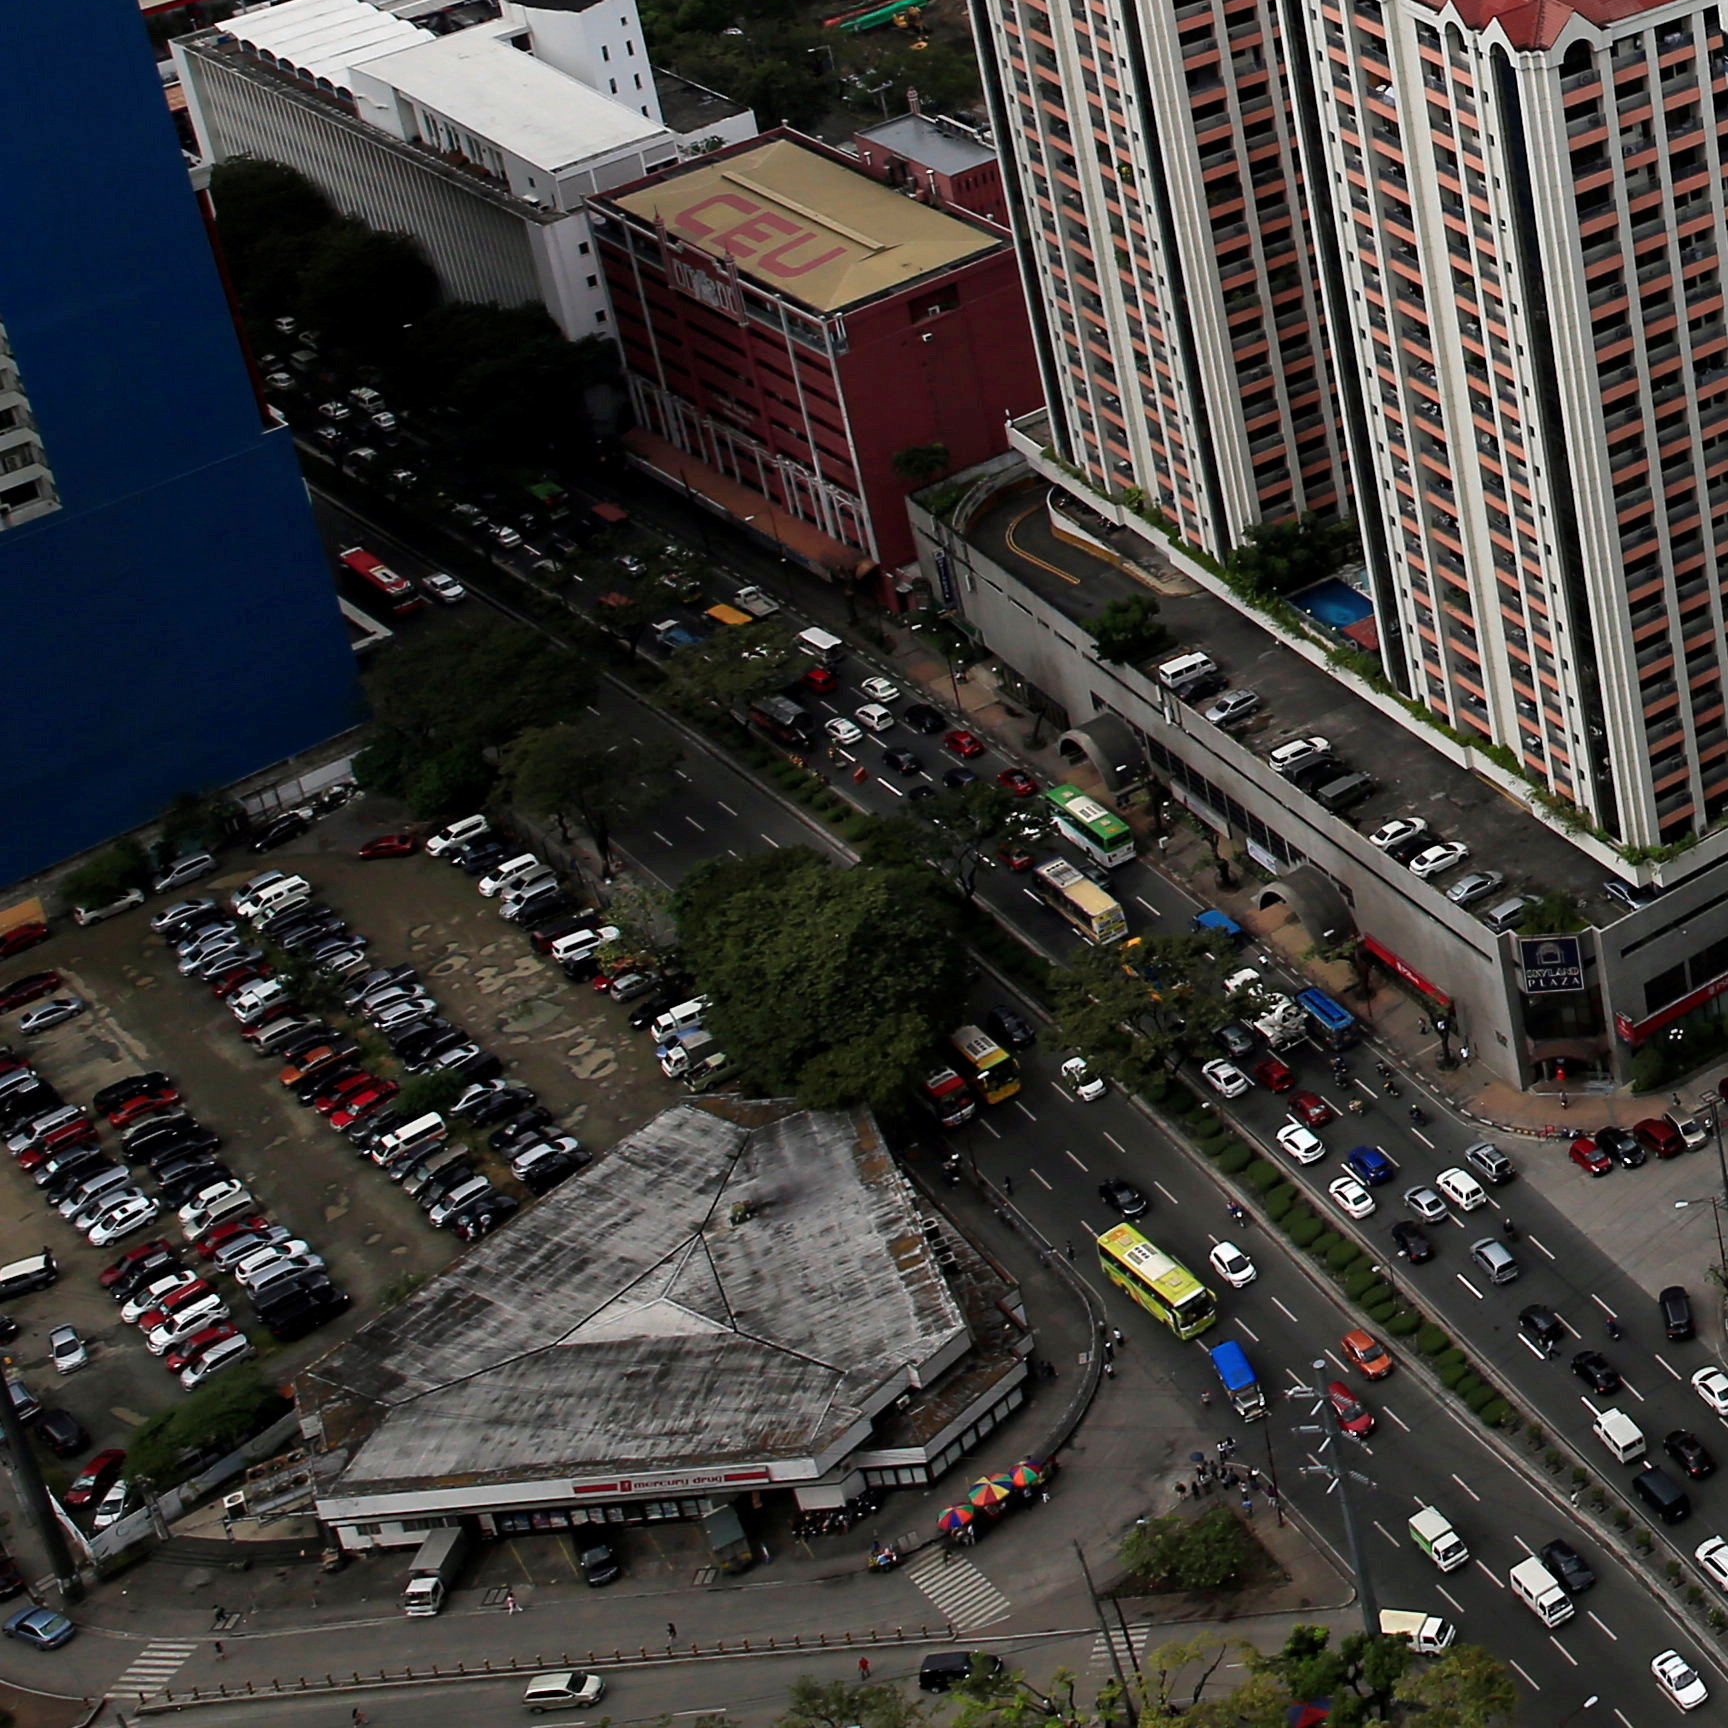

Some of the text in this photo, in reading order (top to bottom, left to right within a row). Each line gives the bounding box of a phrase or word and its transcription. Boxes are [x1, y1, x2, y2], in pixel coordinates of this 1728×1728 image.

[674, 193, 848, 279] CEU
[1528, 978, 1580, 989] PLAZA
[633, 1474, 723, 1490] mercury drug
